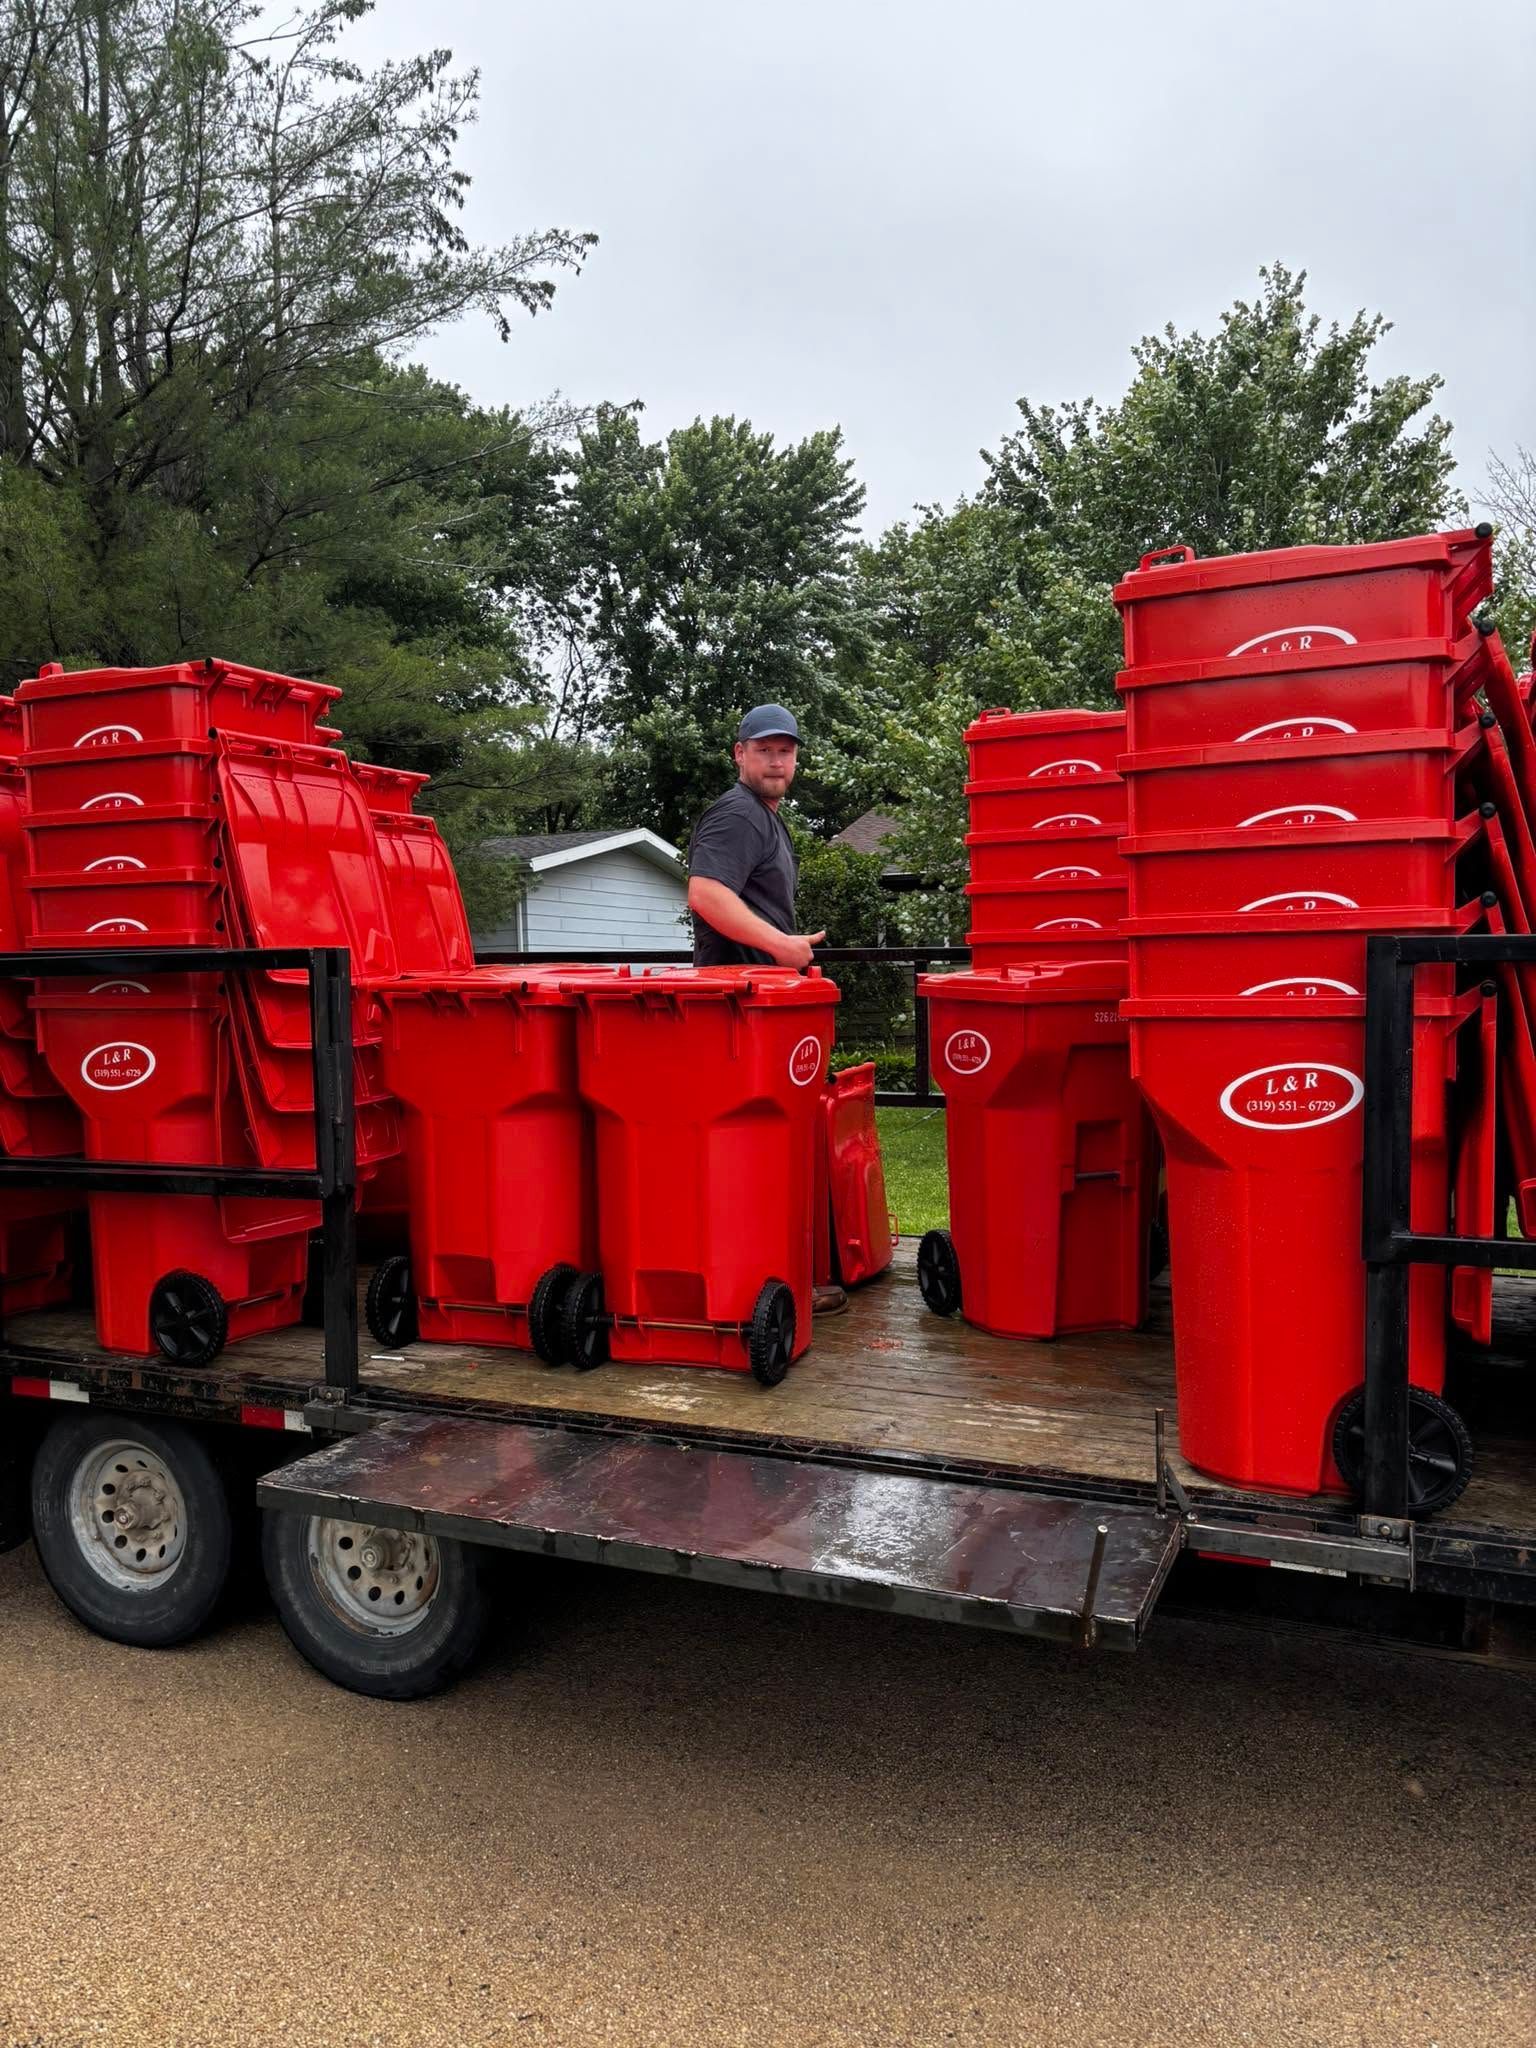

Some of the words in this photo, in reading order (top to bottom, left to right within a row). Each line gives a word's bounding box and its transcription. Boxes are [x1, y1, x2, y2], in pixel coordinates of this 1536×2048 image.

[1300, 635, 1312, 650] R
[104, 1053, 111, 1065] L
[112, 1051, 120, 1063] &
[123, 1048, 131, 1061] R
[94, 1069, 110, 1078] (319)
[125, 1069, 141, 1077] 6729
[1266, 1078, 1279, 1095] L
[1283, 1075, 1299, 1092] &
[1304, 1072, 1319, 1089] R
[1246, 1100, 1276, 1113] (319)
[1278, 1100, 1297, 1111] 551
[1308, 1100, 1336, 1111] 6729
